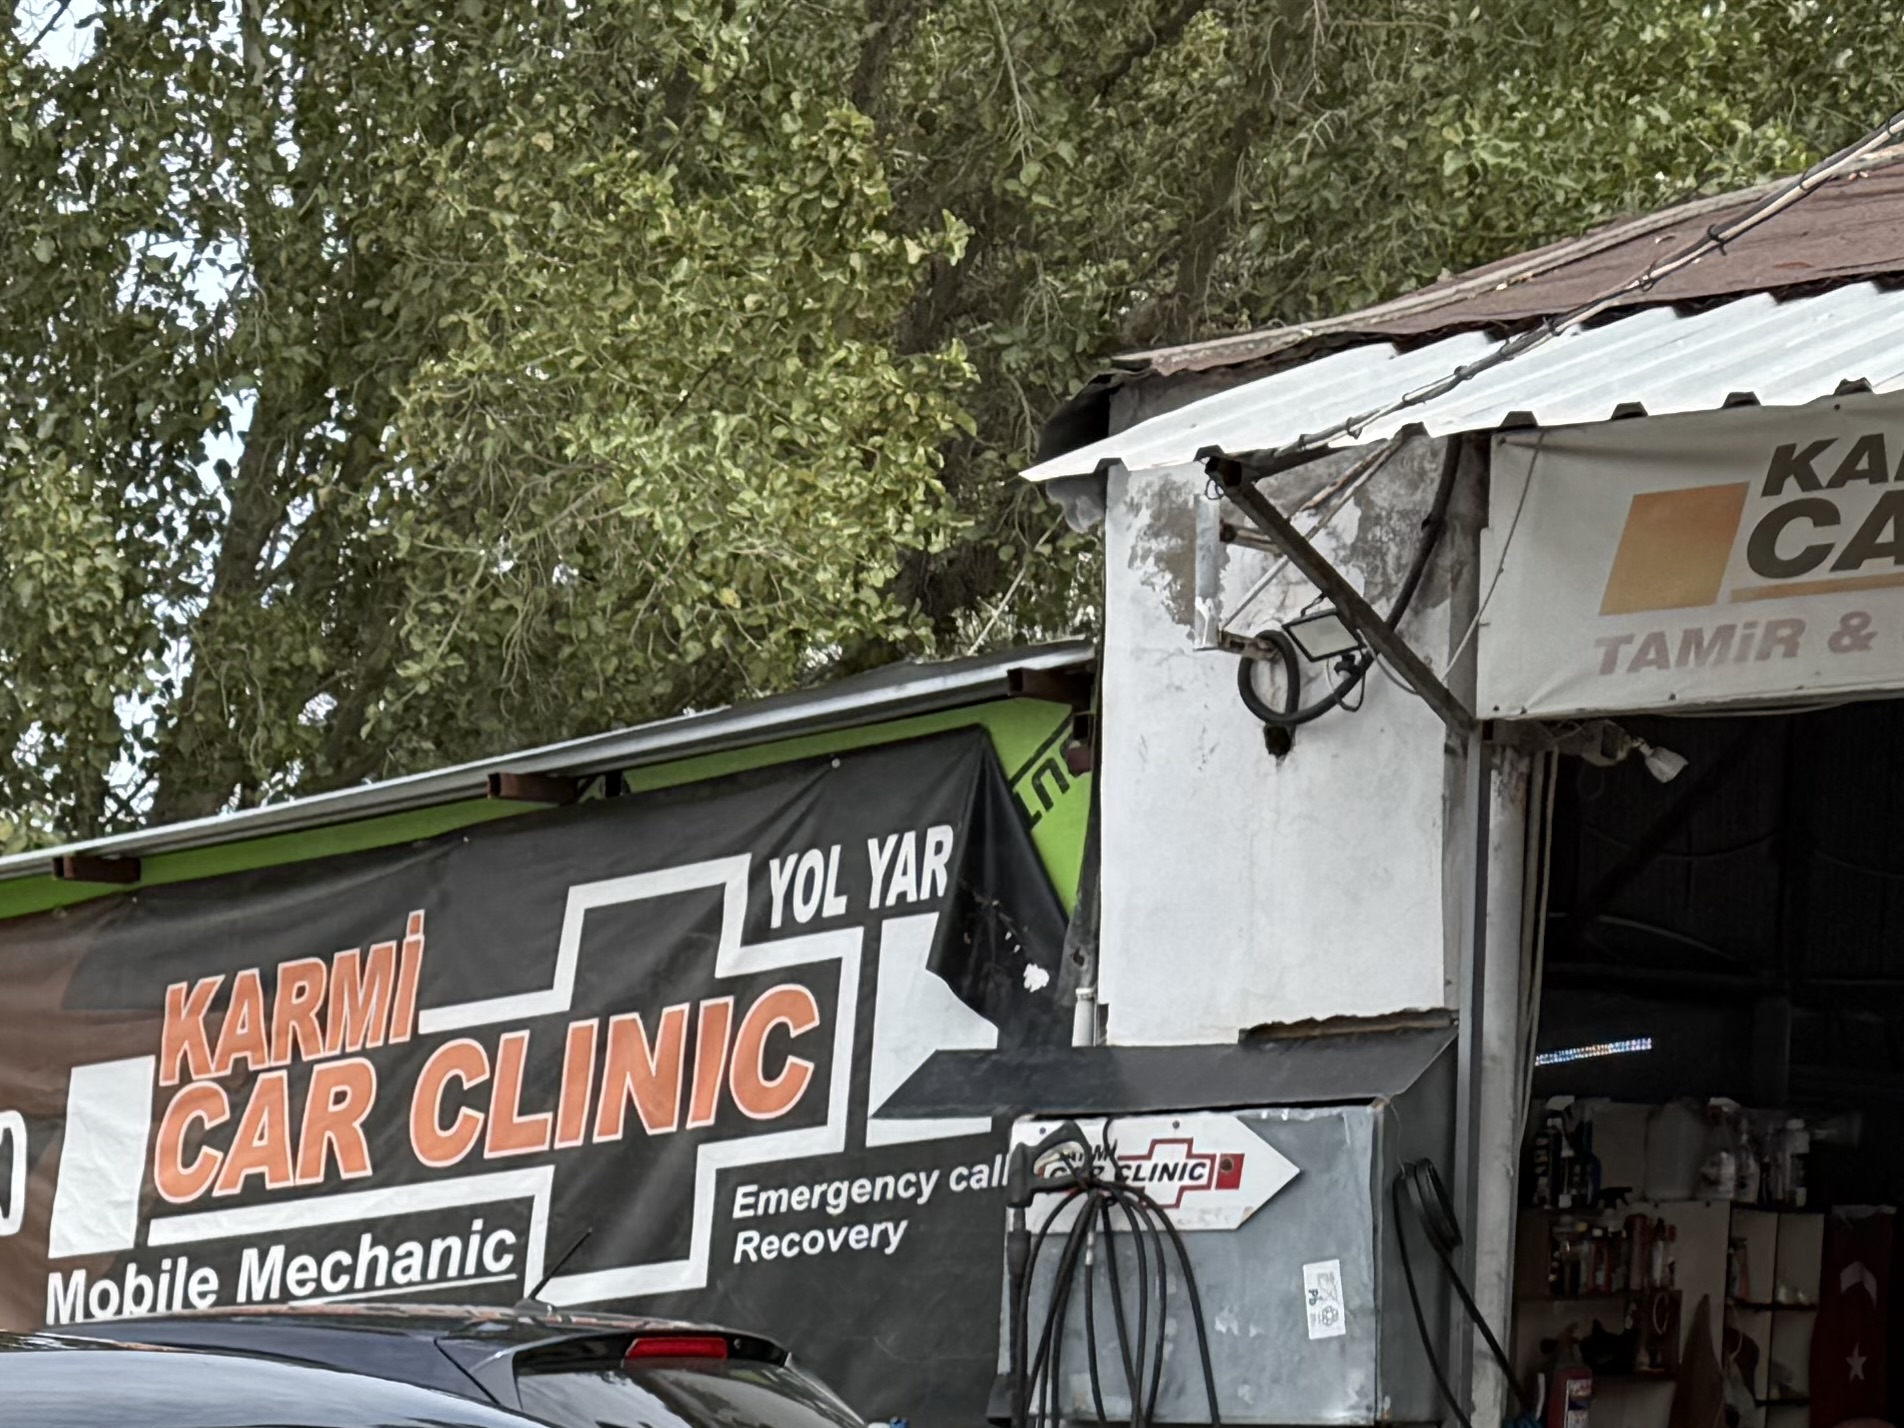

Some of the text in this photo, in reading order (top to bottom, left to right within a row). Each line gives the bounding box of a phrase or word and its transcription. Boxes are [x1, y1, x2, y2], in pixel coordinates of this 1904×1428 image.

[1761, 433, 1904, 497] KA
[1828, 611, 1878, 655] &
[769, 825, 953, 928] YOL YAR
[153, 983, 820, 1203] CAR CLINIC
[732, 1169, 940, 1218] Emergency
[46, 1218, 517, 1325] Mobile Mechanic
[733, 1219, 908, 1264] Recovery
